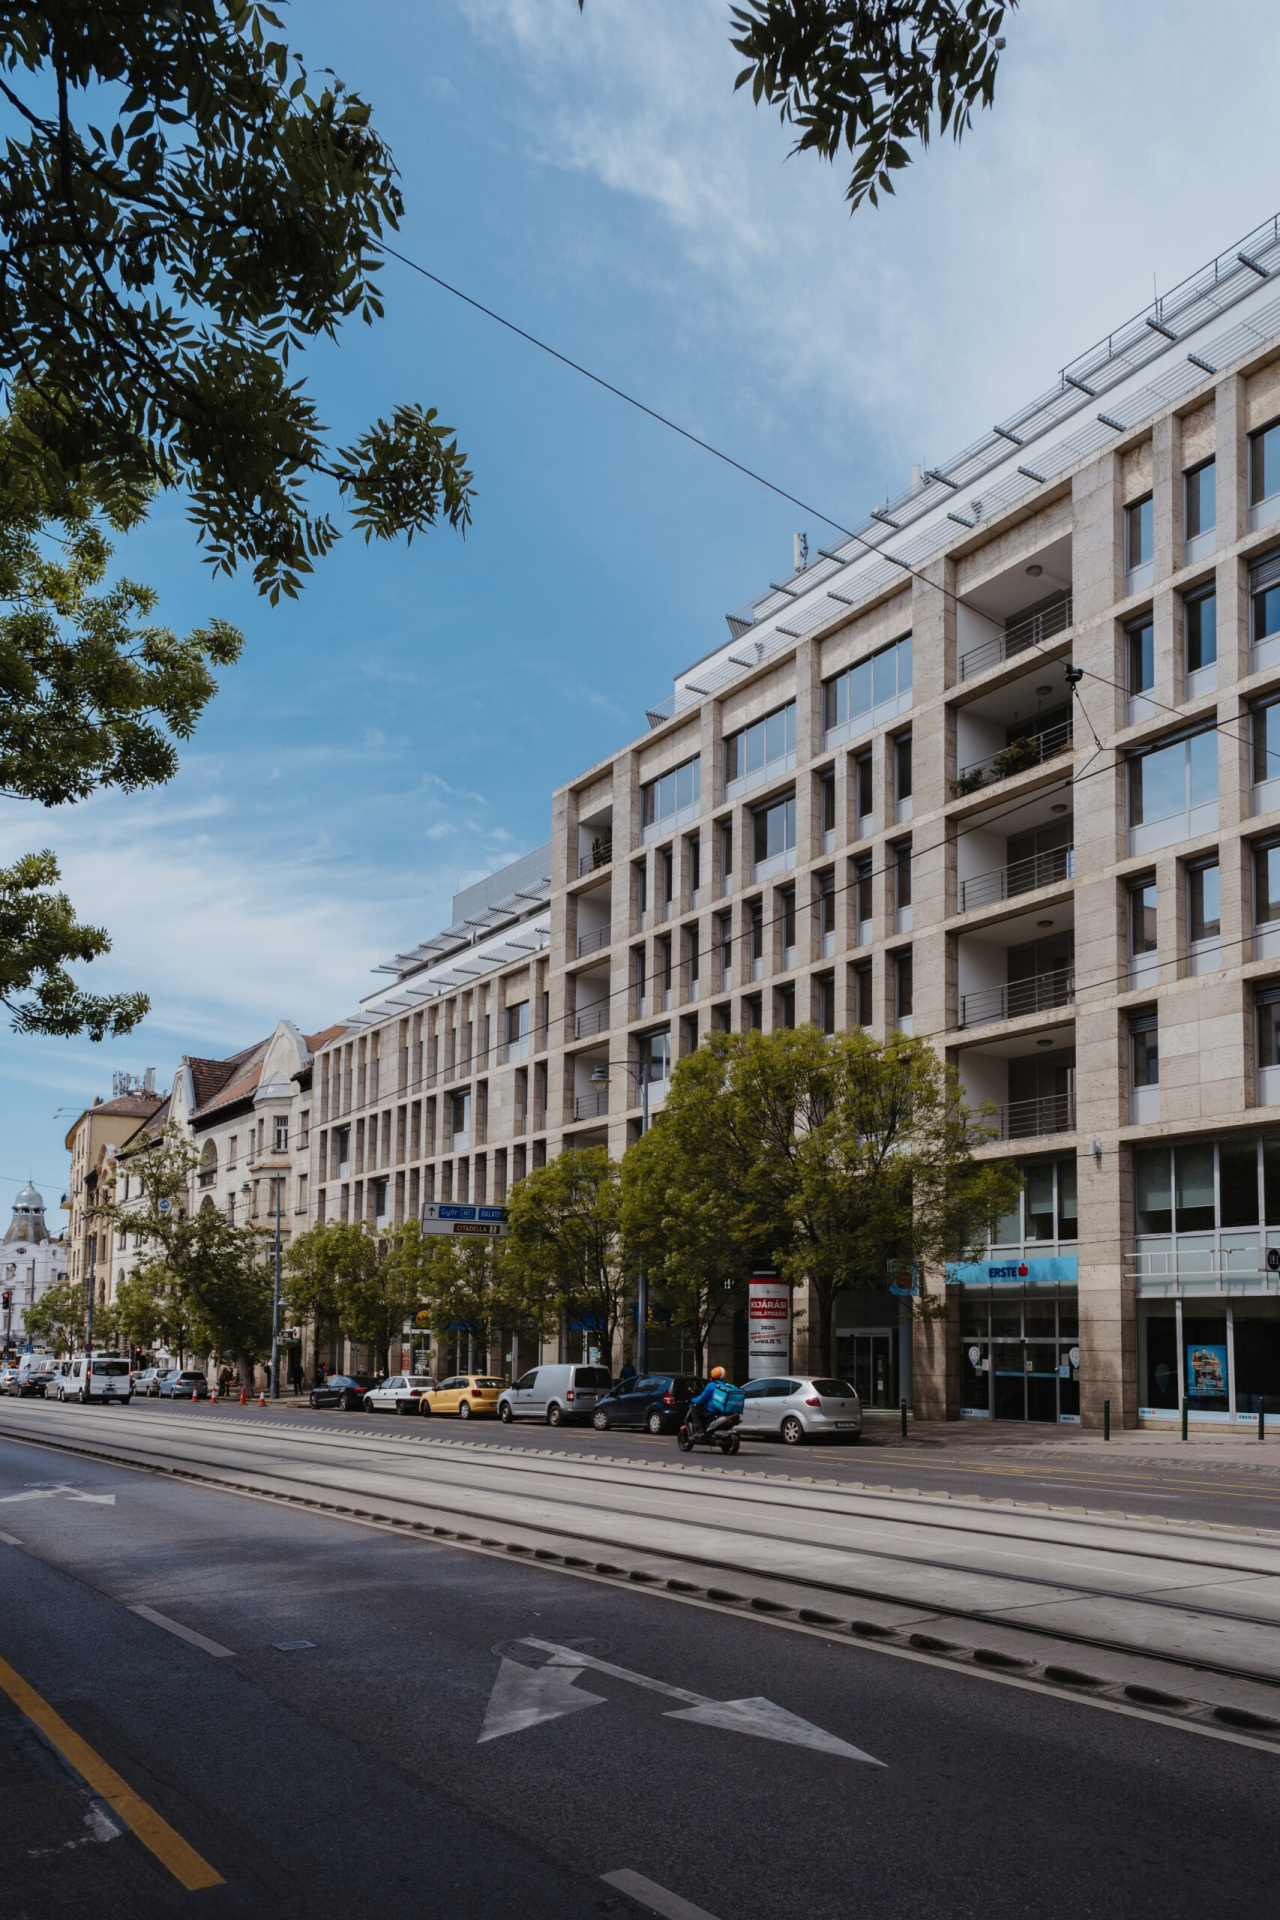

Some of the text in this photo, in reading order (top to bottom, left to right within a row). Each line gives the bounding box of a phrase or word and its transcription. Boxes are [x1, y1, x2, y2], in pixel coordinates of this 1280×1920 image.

[441, 1208, 459, 1217] Győr
[481, 1210, 501, 1218] BALATO
[988, 1267, 1018, 1278] ERSTE
[751, 1299, 787, 1309] KIJÁRÁSI
